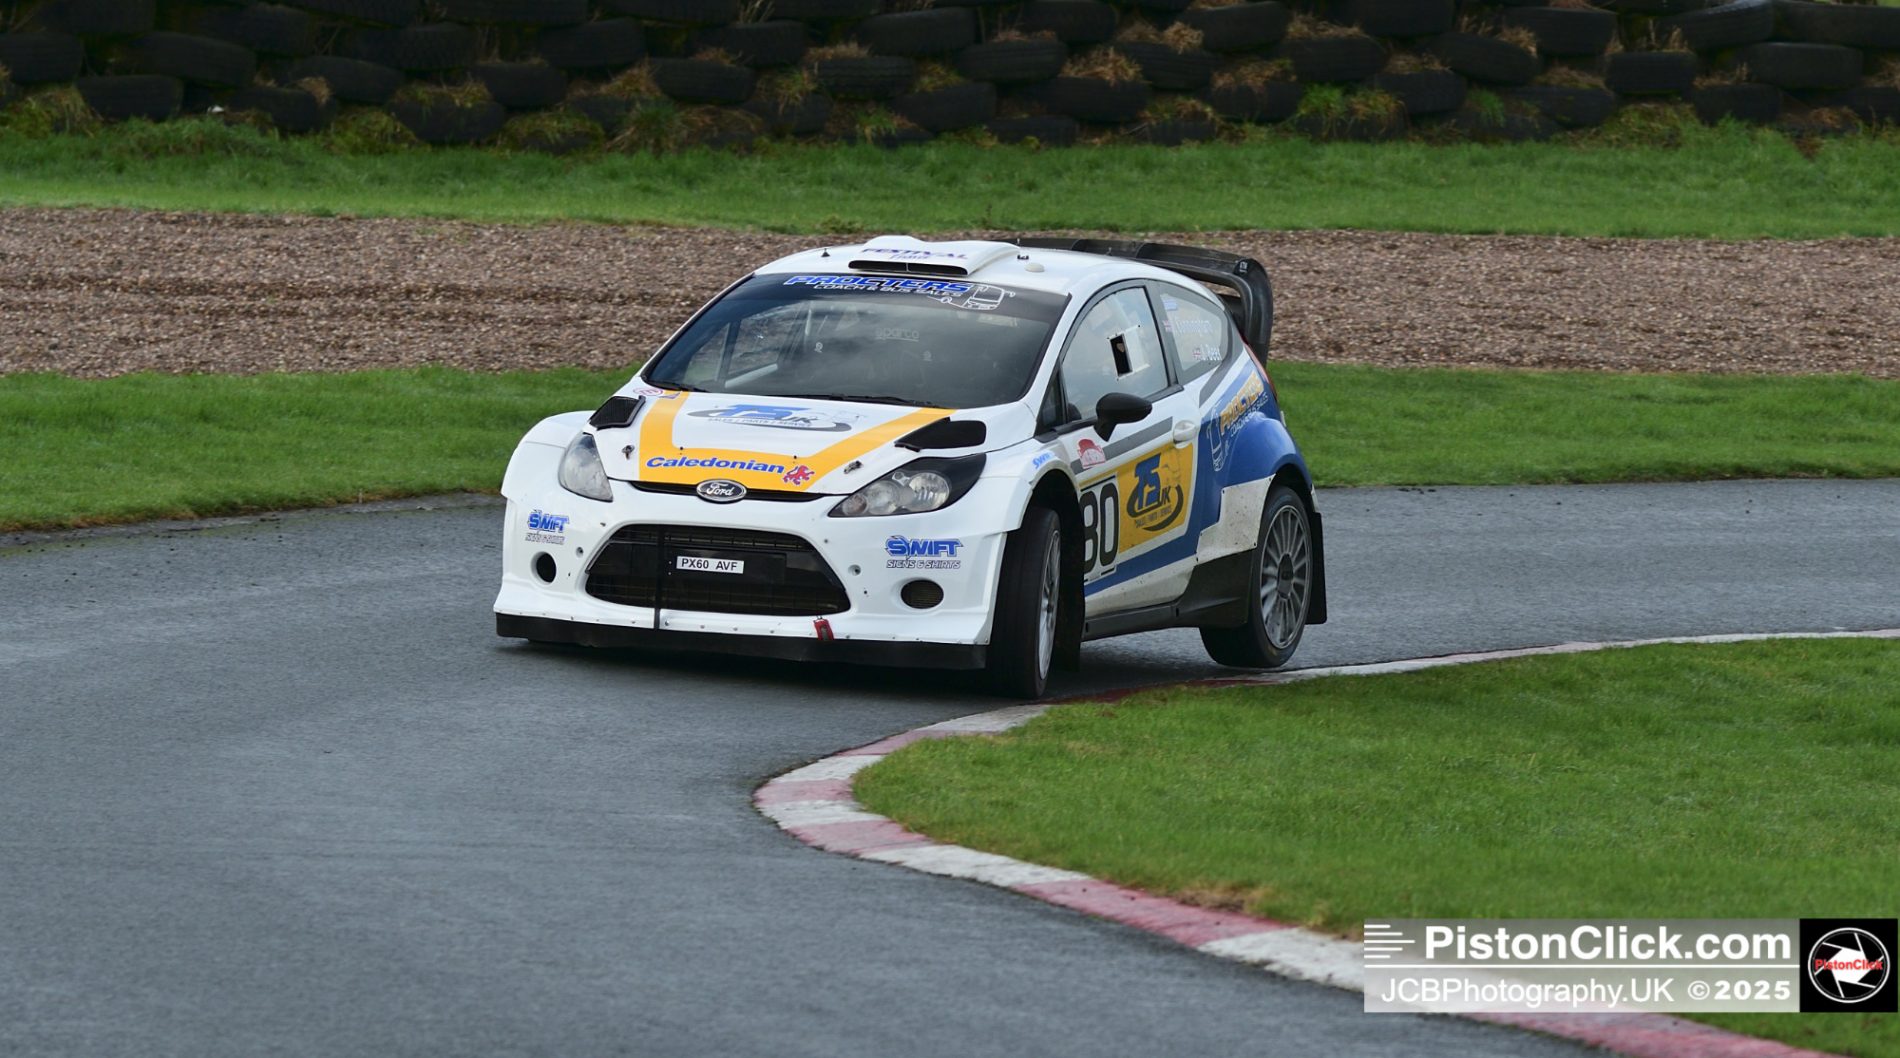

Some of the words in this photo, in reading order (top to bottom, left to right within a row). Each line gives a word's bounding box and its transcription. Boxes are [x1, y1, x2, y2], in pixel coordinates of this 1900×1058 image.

[783, 275, 975, 293] PROCTERS
[917, 289, 963, 297] SALES
[646, 456, 785, 474] Caledonian
[706, 482, 734, 497] Ford
[528, 510, 569, 533] SWIFT
[1079, 482, 1119, 574] 80
[886, 536, 963, 558] SWIFT
[681, 558, 709, 569] PX60
[715, 561, 738, 571] AVF
[886, 560, 916, 568] SIGNS
[925, 560, 961, 569] SHIRTS
